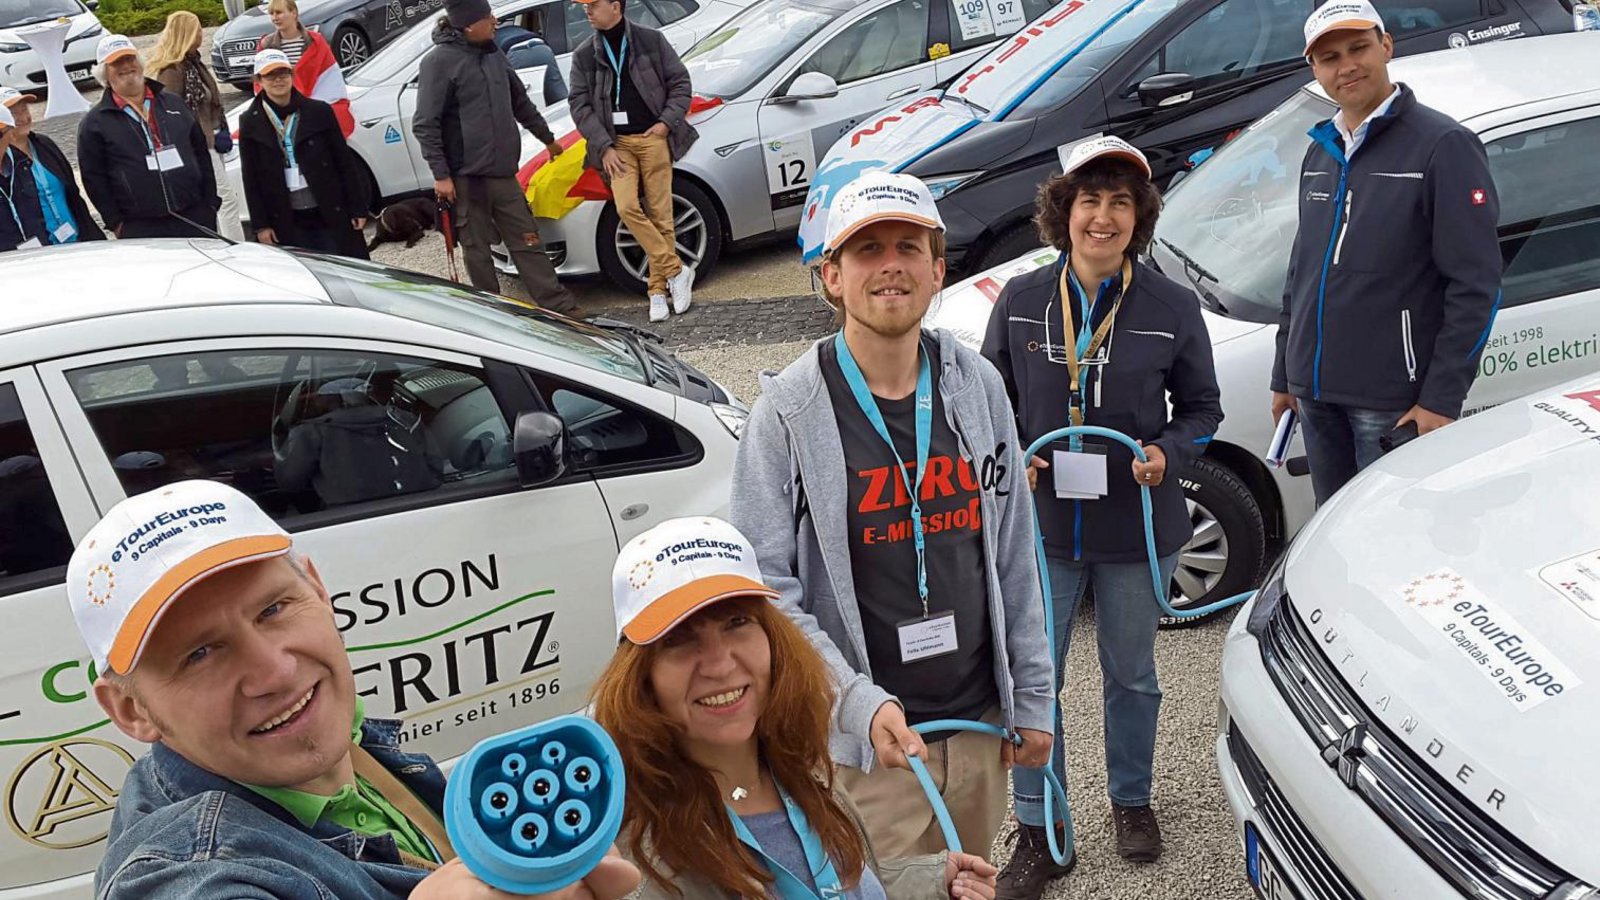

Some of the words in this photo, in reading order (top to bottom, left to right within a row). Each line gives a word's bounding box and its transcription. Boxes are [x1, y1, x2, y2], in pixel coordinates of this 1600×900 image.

[959, 0, 984, 16] 109
[997, 1, 1013, 15] 97
[1467, 21, 1521, 41] Ensinger
[778, 159, 807, 187] 12
[858, 185, 920, 200] eTourEurope
[1486, 334, 1508, 350] seit
[1513, 326, 1543, 344] 1998
[1476, 350, 1518, 378] 0%
[1526, 333, 1598, 368] elektri
[1534, 402, 1597, 433] QUALITY
[111, 502, 226, 562] eTourEurope
[131, 552, 139, 561] 9
[139, 526, 183, 554] Capitals
[189, 520, 198, 528] 9
[199, 515, 227, 526] Days
[656, 538, 743, 562] eTourEurope
[678, 551, 713, 562] Capitals
[331, 553, 500, 633] SSION
[1443, 623, 1456, 632] 9
[1451, 629, 1490, 666] Capitals
[1491, 668, 1505, 678] 9
[1499, 677, 1527, 703] Days
[1453, 601, 1564, 697] eTourEurope
[455, 700, 498, 727] seit
[508, 678, 561, 708] 1896
[1310, 608, 1506, 811] OUTLANDER
